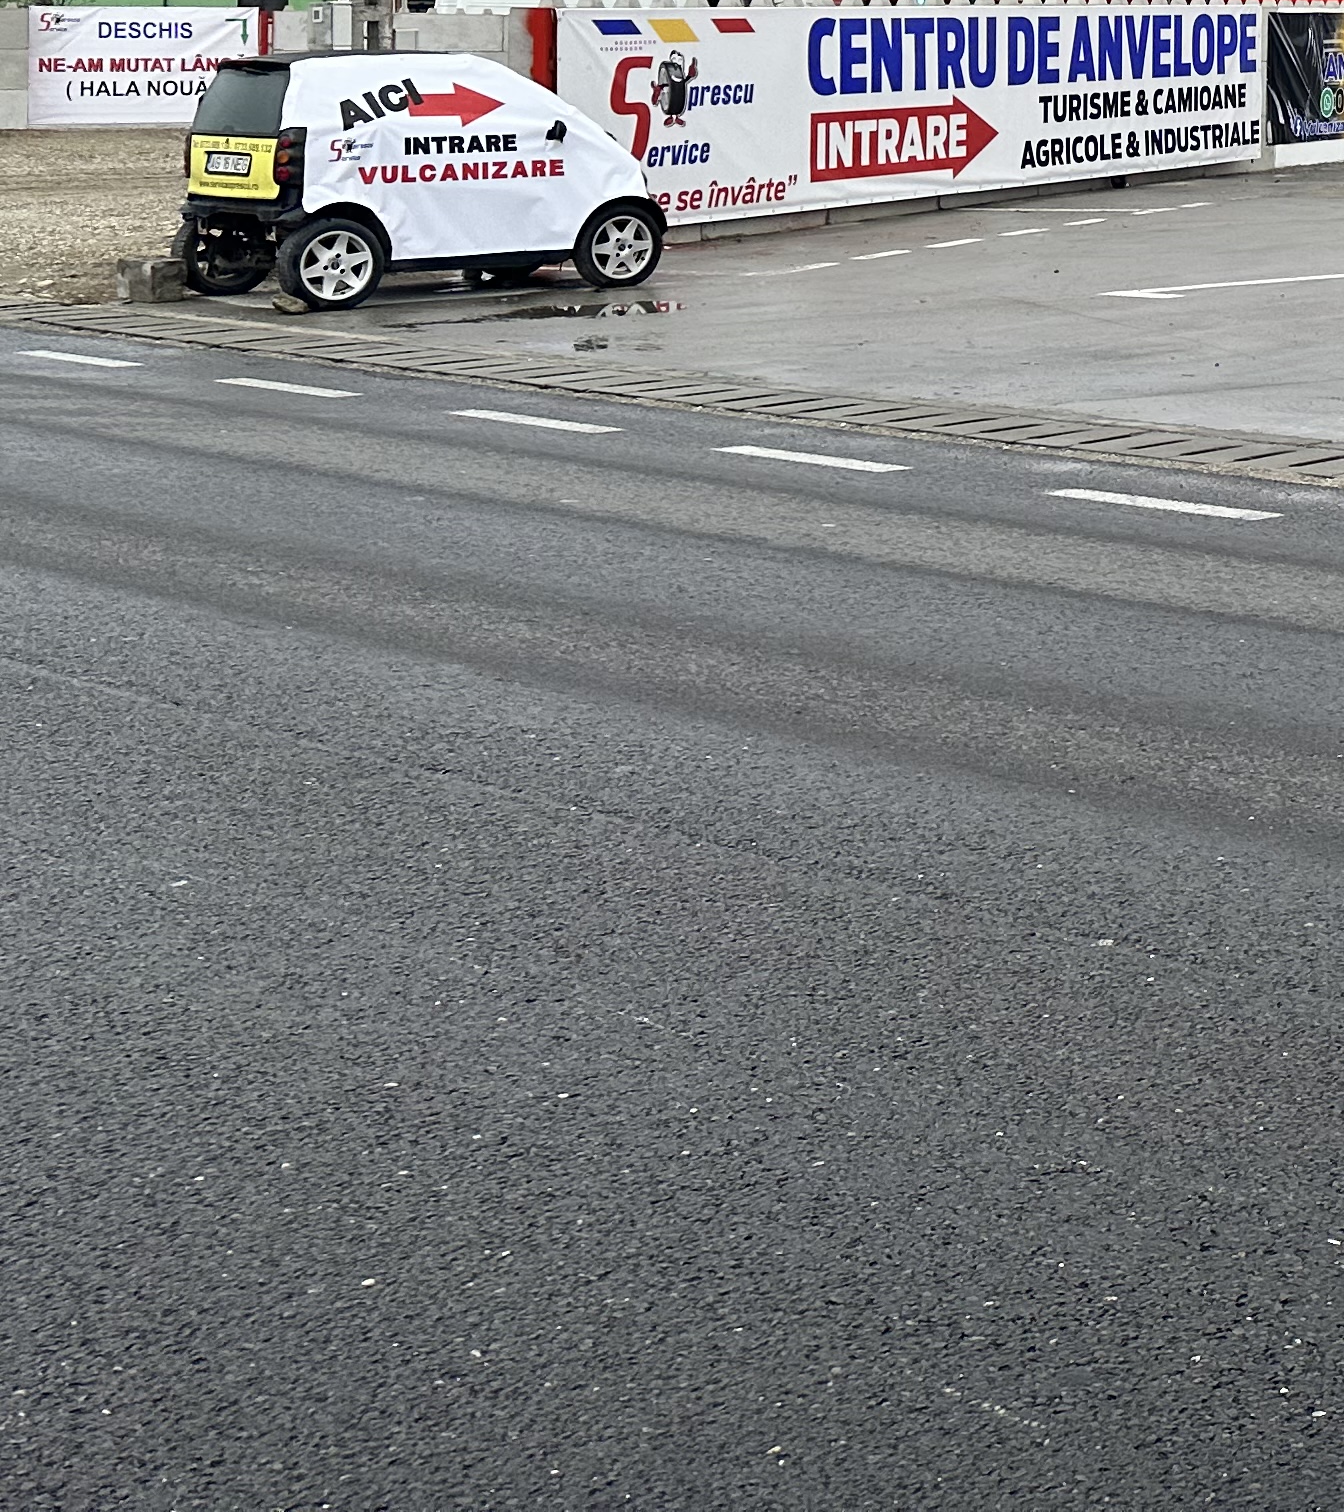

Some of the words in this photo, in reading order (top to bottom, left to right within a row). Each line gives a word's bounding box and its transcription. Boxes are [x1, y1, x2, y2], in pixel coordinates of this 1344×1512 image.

[98, 22, 193, 39] DESCHIS
[38, 58, 103, 73] NE-AM
[109, 58, 174, 73] MUTAT
[180, 53, 246, 73] LÂN
[807, 16, 997, 96] CENTRU
[1007, 16, 1061, 86] DE
[1067, 13, 1257, 83] ANVELOPE
[80, 81, 140, 96] HALA
[147, 76, 207, 96] NOUĂ
[339, 78, 424, 131] AICI
[1039, 89, 1130, 124] TURISME
[1135, 92, 1149, 116] &
[1152, 83, 1247, 114] CAMIOANE
[404, 134, 517, 155] INTRARE
[816, 113, 968, 170] INTRARE
[1020, 132, 1122, 169] AGRICOLE
[1125, 132, 1140, 157] &
[1145, 119, 1260, 156] INDUSTRIALE
[358, 159, 565, 185] VULCANIZARE
[675, 189, 703, 211] se
